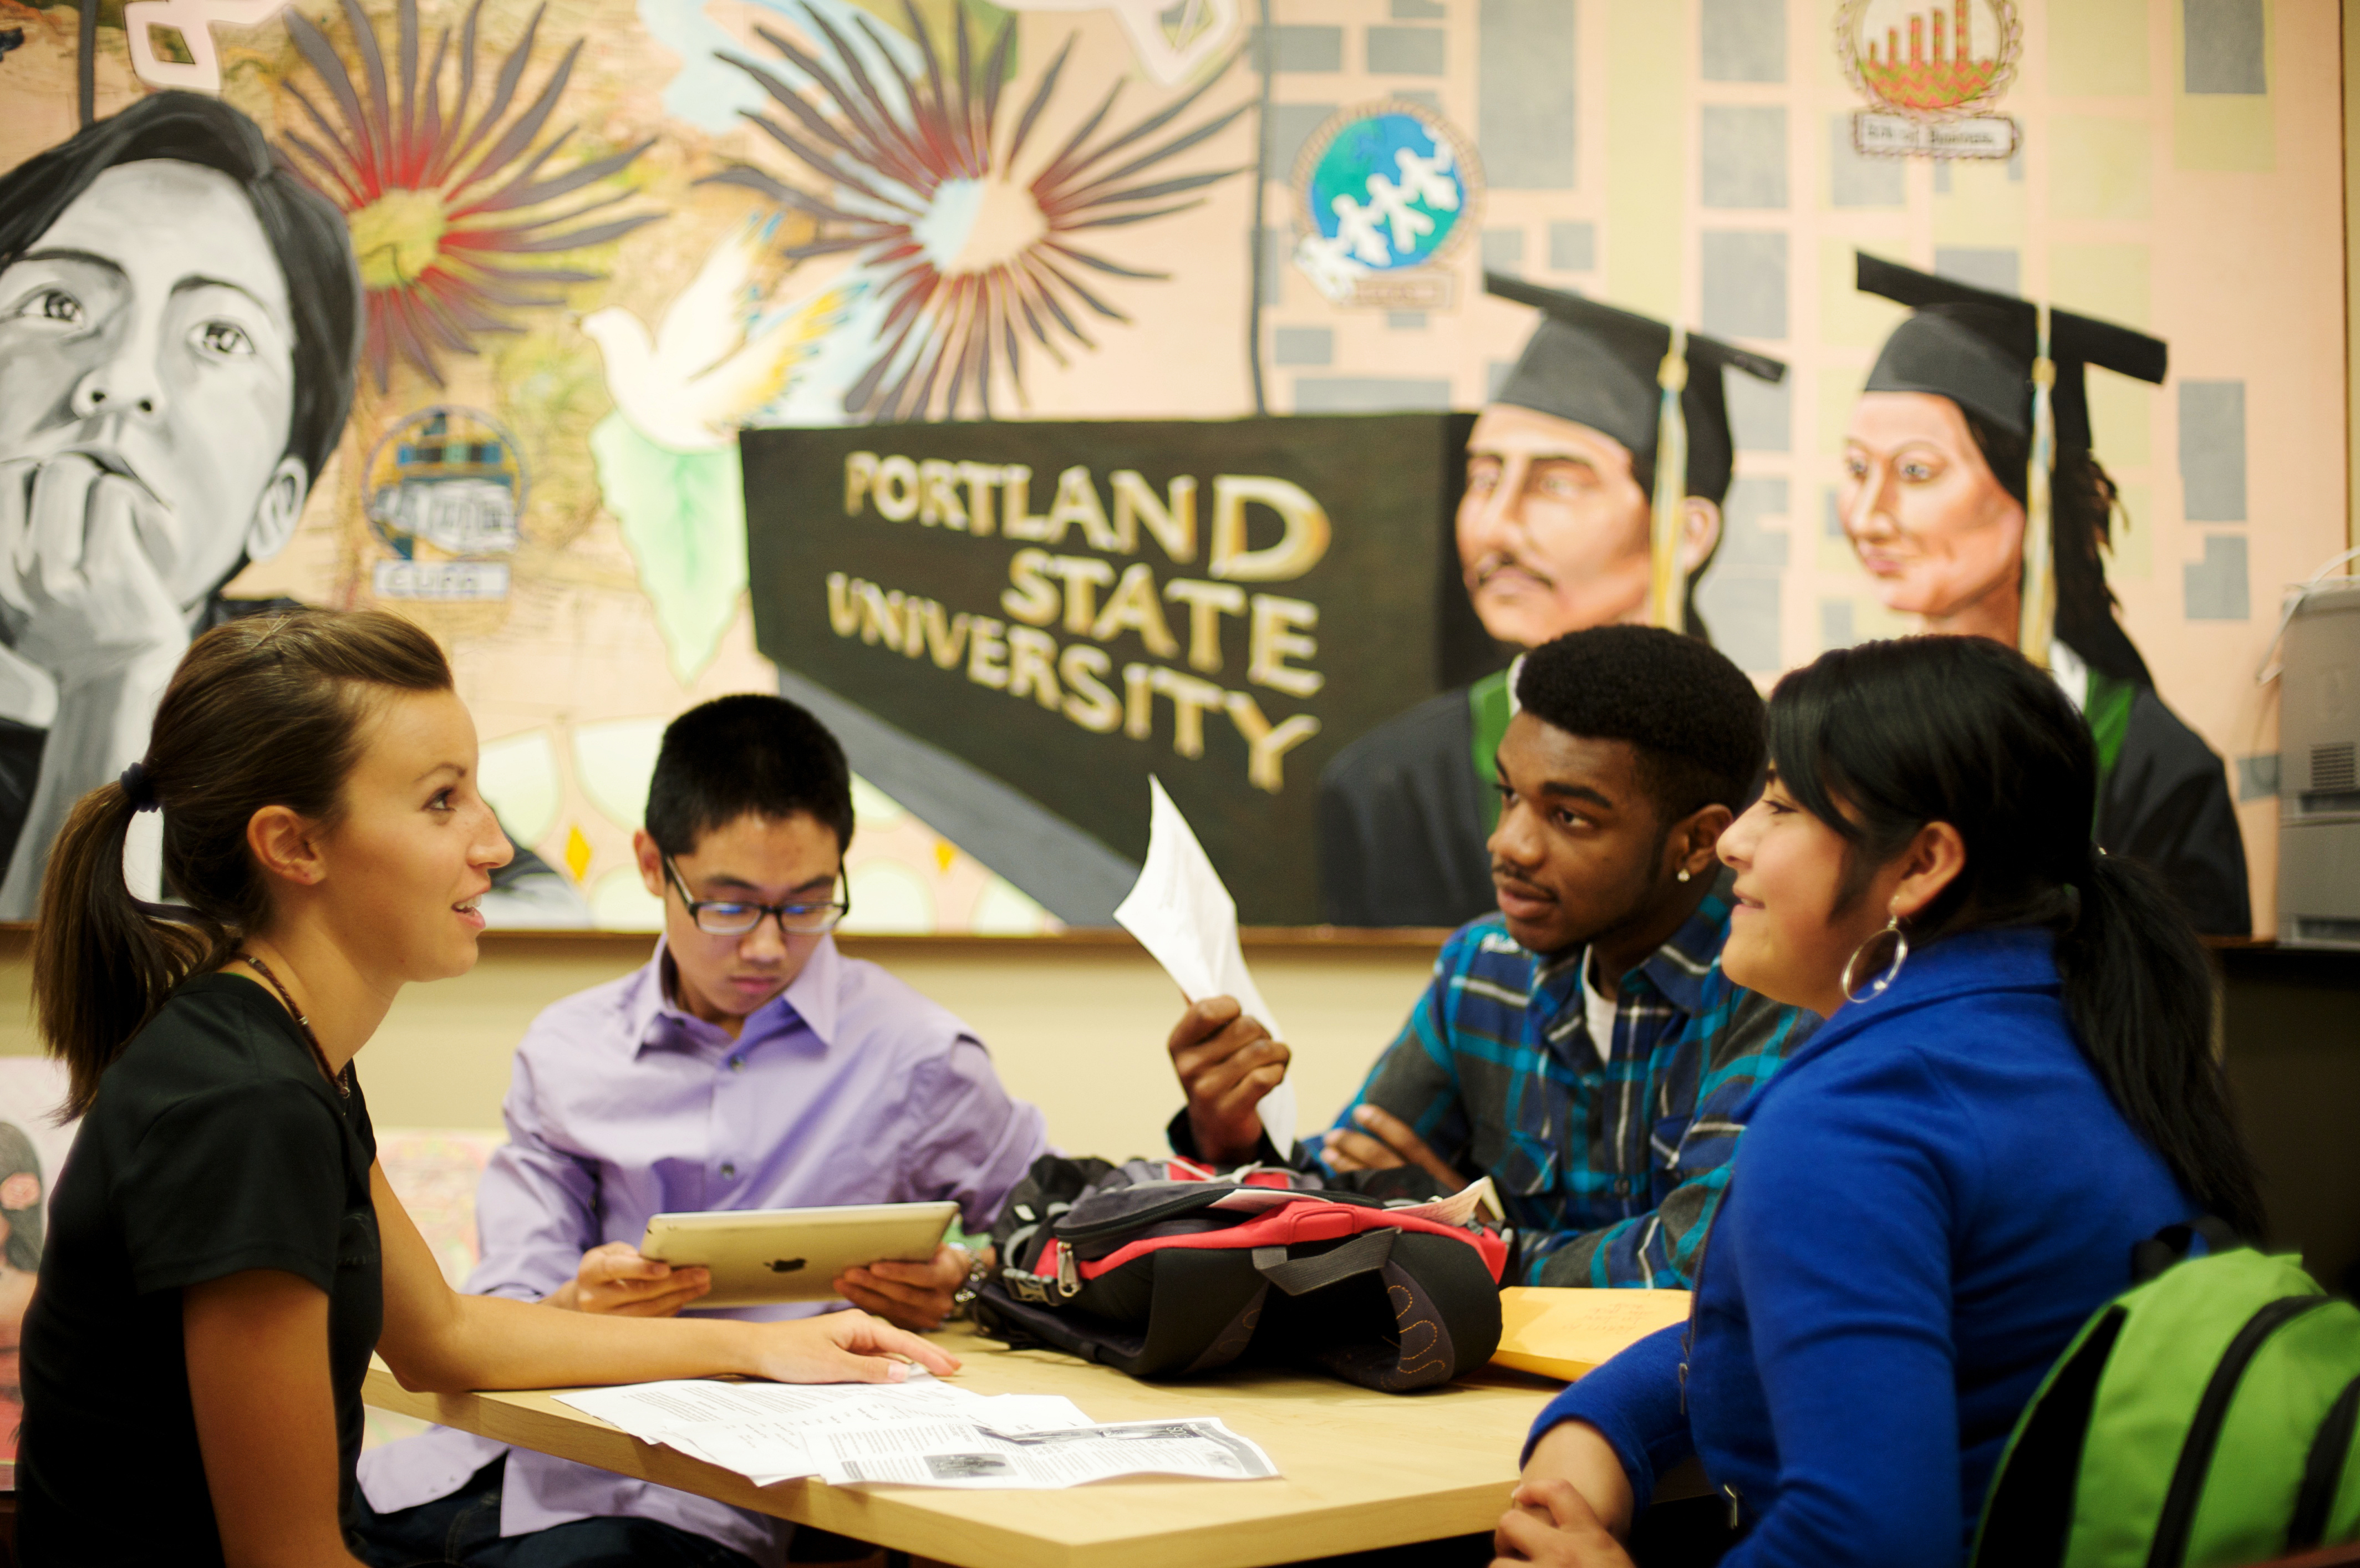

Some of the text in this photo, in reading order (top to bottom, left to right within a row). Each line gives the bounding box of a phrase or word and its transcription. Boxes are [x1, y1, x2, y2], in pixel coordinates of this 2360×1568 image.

[845, 451, 1331, 582] PORTLAND
[826, 571, 1322, 793] UNIVERSITY
[1001, 548, 1325, 698] STATE
